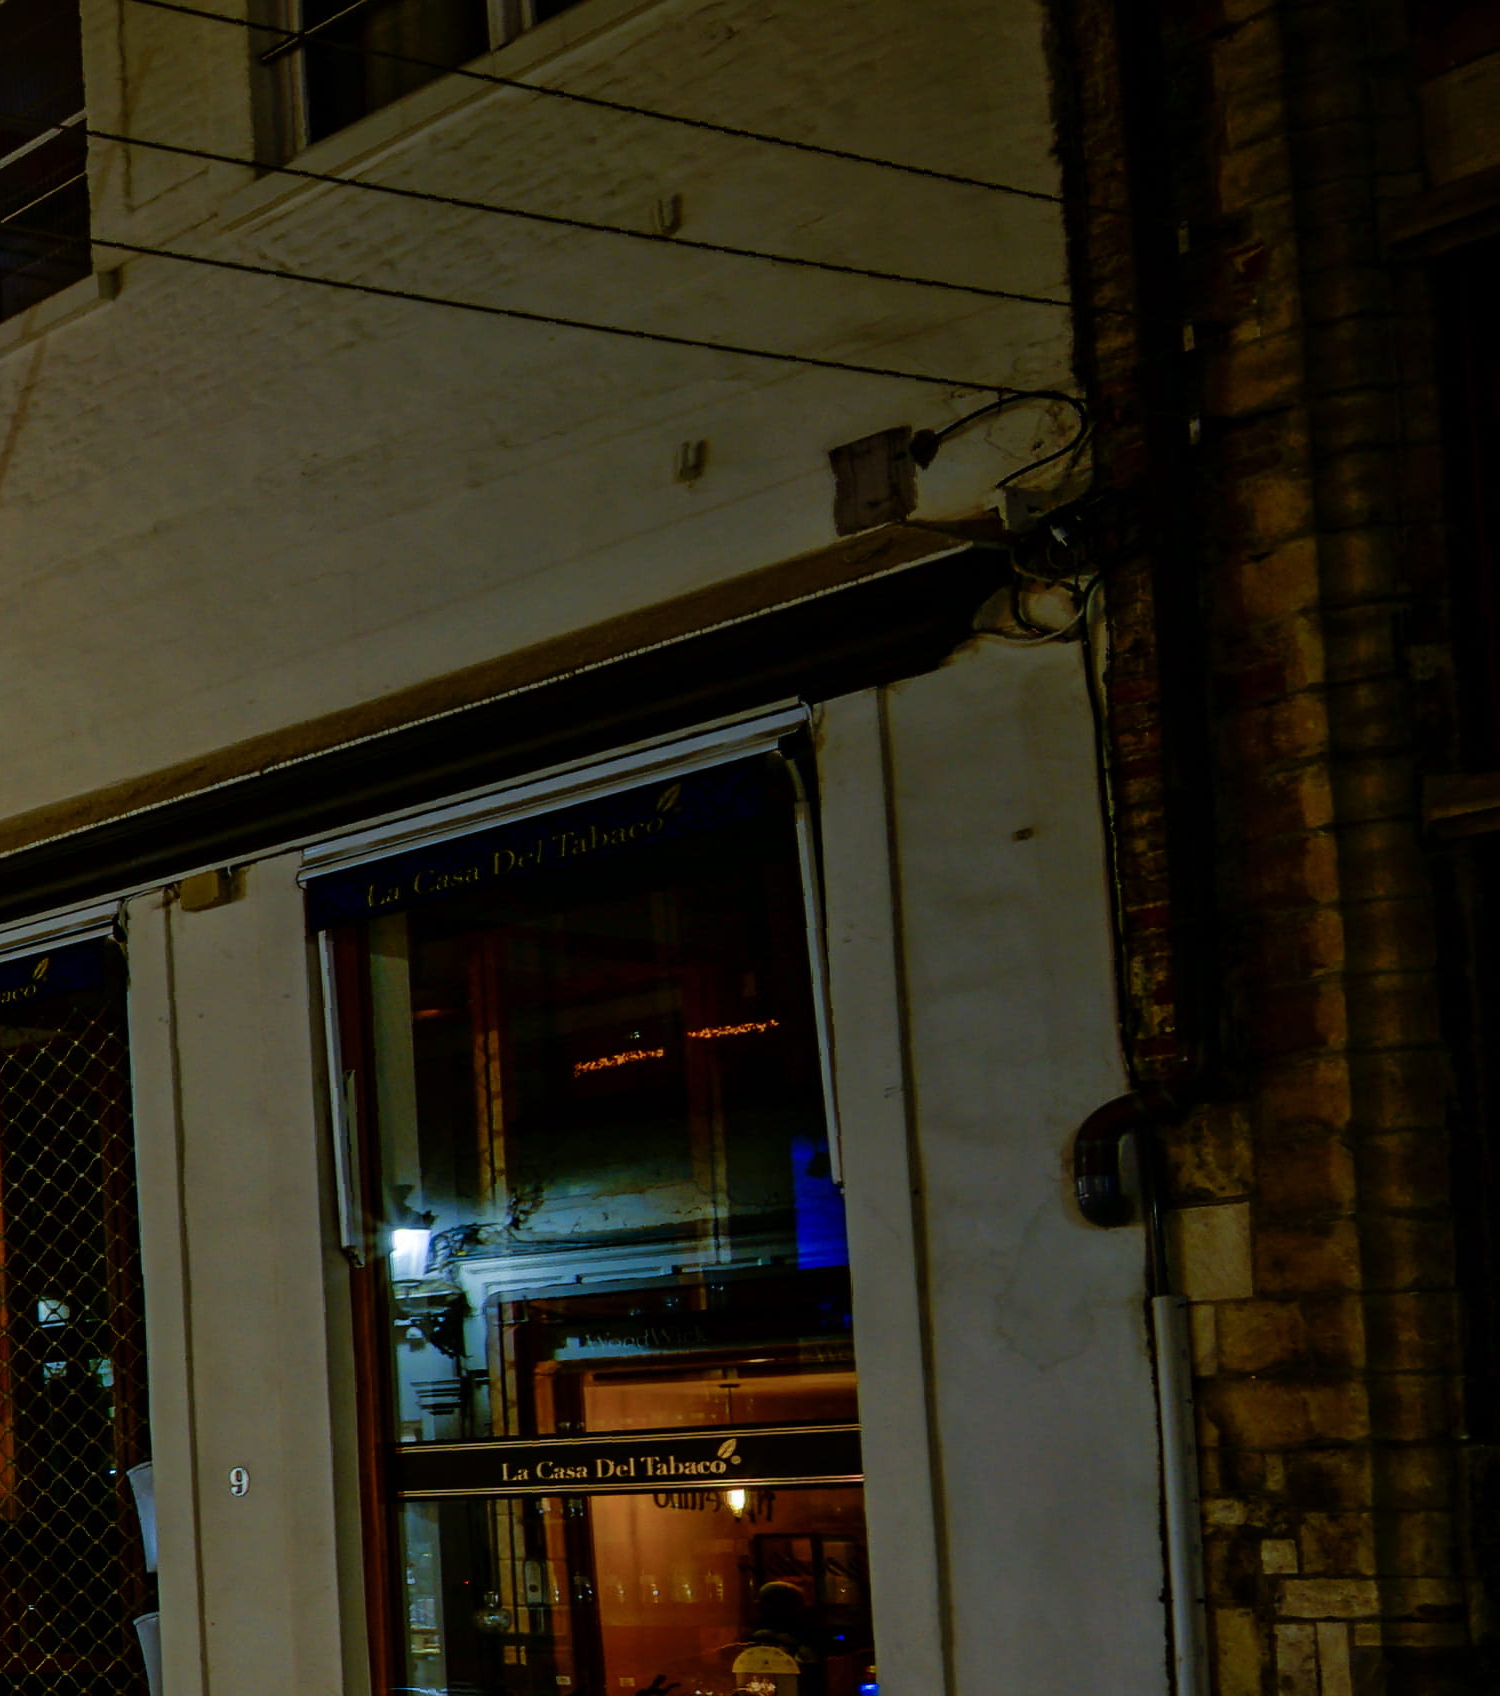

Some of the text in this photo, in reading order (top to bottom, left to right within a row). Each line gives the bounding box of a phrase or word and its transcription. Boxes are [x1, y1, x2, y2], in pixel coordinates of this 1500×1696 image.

[366, 817, 665, 908] La Casa Del Tabaco
[230, 1468, 249, 1497] 9
[502, 1455, 727, 1481] La Casa Del Tabaco
